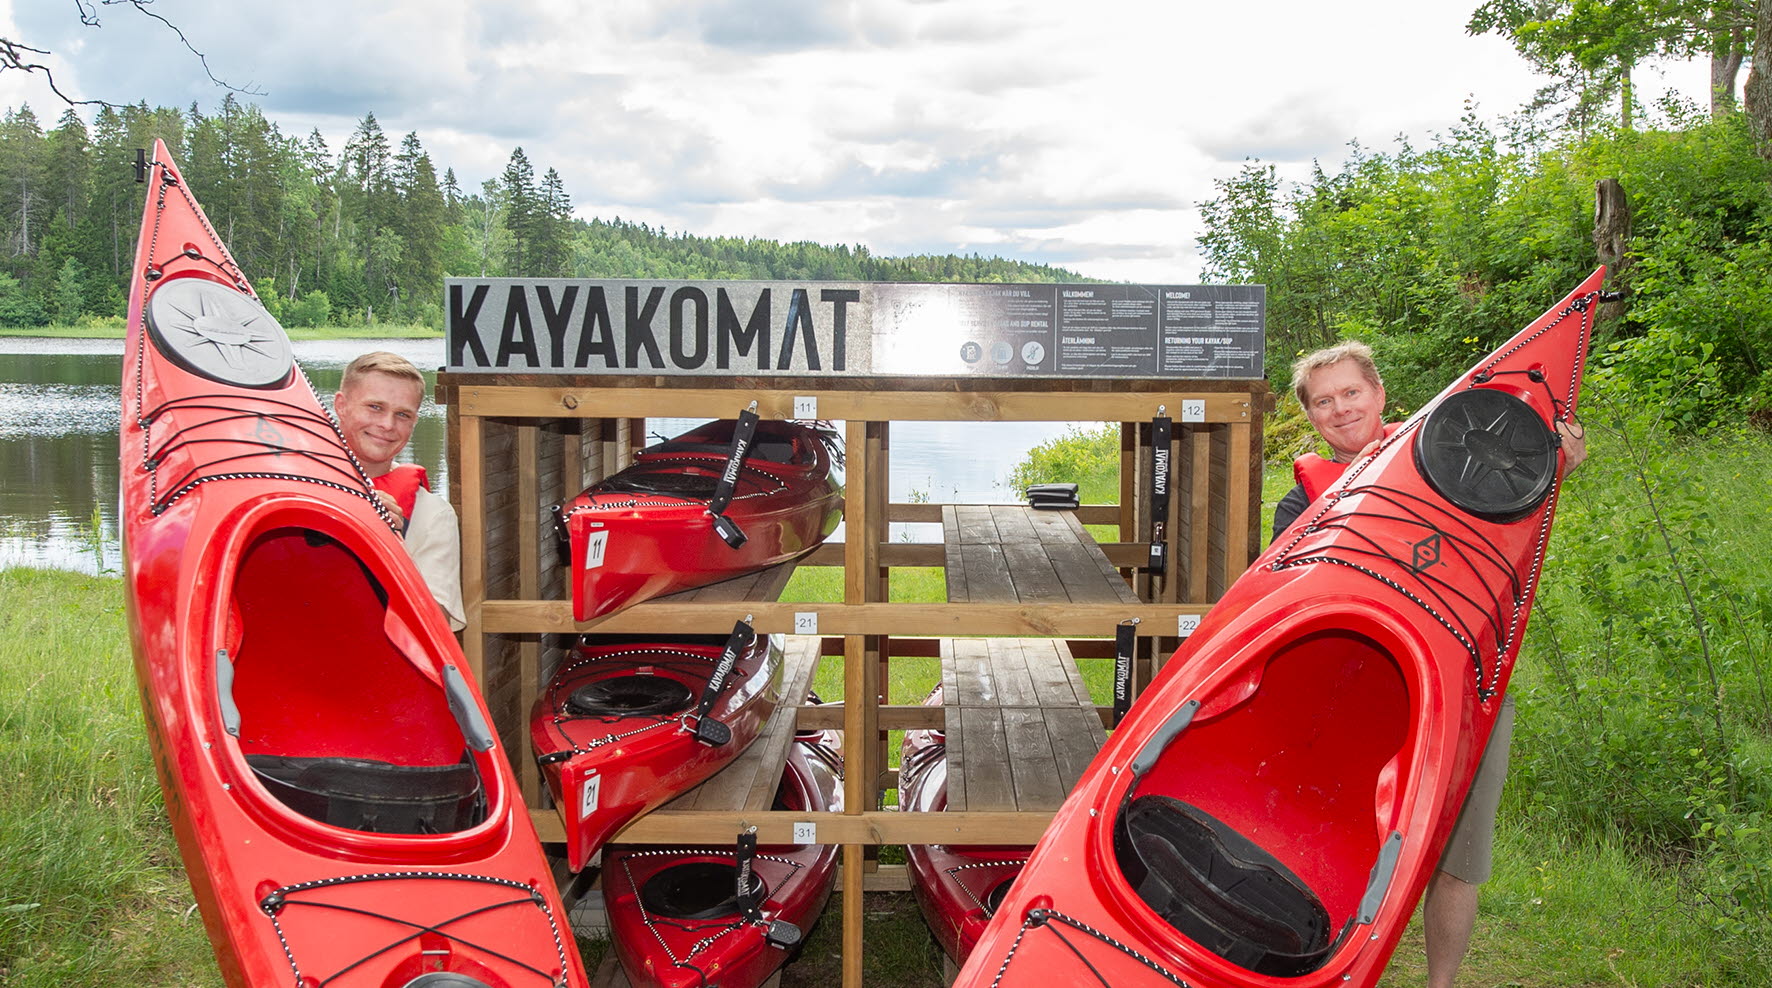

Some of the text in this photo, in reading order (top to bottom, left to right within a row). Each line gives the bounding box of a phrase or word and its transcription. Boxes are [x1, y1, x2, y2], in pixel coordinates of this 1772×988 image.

[1020, 290, 1031, 298] VILL
[449, 284, 861, 372] KAYAKOMAT
[1191, 337, 1205, 345] YOUR
[725, 438, 748, 485] KAYAKOMAT
[1154, 447, 1166, 495] KAYAKOMAT
[592, 538, 603, 560] 11
[708, 647, 735, 693] KAYAKOMAT
[1115, 654, 1127, 701] KAYAKOMAT
[586, 783, 597, 807] 21
